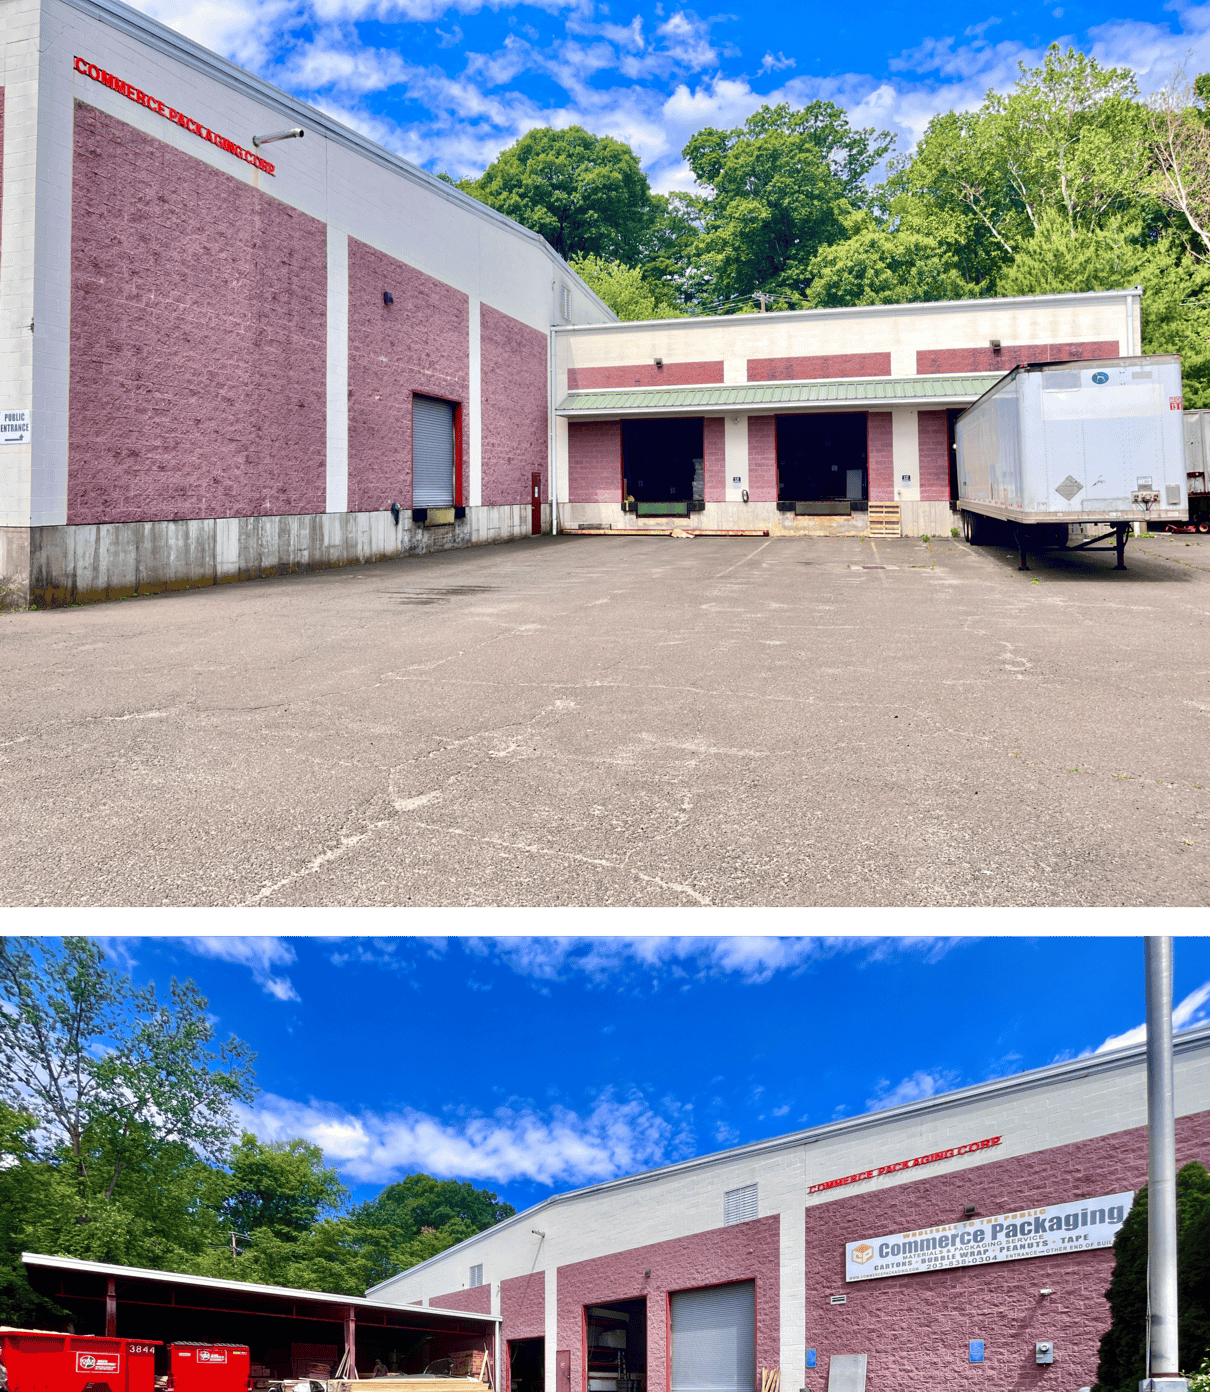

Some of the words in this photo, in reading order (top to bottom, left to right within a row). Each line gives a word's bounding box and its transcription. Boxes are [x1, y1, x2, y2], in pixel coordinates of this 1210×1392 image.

[75, 57, 166, 117] COMMERCE
[169, 107, 244, 160] PACKAGING
[244, 150, 276, 174] CORP
[0, 424, 29, 432] ENTRANCE
[5, 413, 25, 421] PUBLIC
[809, 1170, 874, 1194] COMMERCE
[877, 1148, 955, 1176] PACKAGING
[957, 1136, 1001, 1155] CORP
[879, 1229, 986, 1259] Commerce
[991, 1205, 1124, 1240] Packaging
[903, 1225, 958, 1239] WHOLESALE
[980, 1217, 999, 1226] THE
[1004, 1208, 1047, 1221] PUBLIC
[874, 1260, 912, 1271] CARTONS
[921, 1253, 956, 1264] BUBBLE
[960, 1249, 988, 1259] WRAP
[1000, 1240, 1049, 1253] PEANUTS
[1060, 1233, 1090, 1244] TAPE
[902, 1250, 944, 1260] MATERIALS
[954, 1241, 1002, 1252] PACKAGING
[1005, 1234, 1044, 1245] SERVICE
[926, 1255, 998, 1269] 203-838-0304
[1070, 1243, 1083, 1251] END
[129, 1345, 155, 1354] 3844
